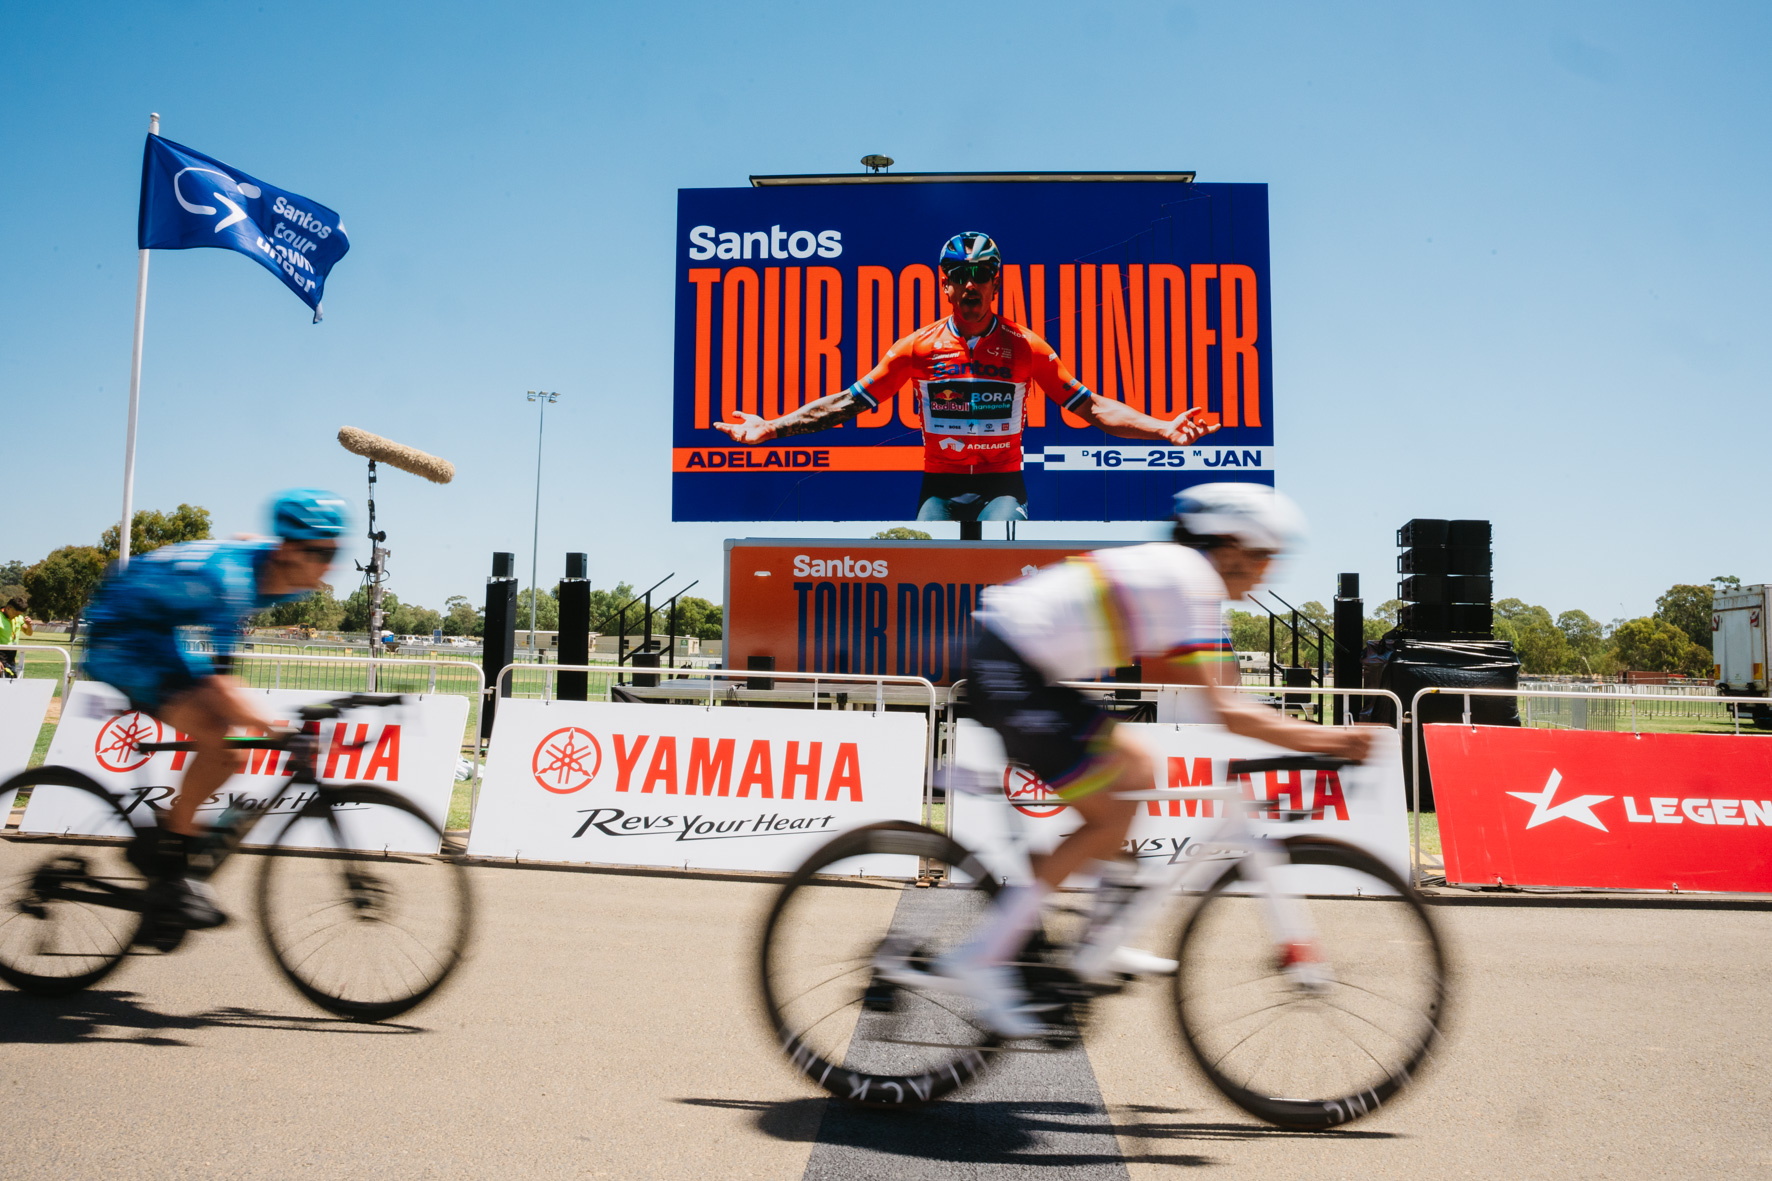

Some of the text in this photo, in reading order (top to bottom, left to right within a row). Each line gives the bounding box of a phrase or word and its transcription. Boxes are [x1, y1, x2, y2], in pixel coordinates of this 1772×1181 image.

[272, 196, 332, 240] Santos
[274, 222, 317, 254] tour
[689, 225, 843, 260] Santos
[265, 234, 314, 275] own
[688, 264, 1262, 430] TOUR DON UNDER
[932, 361, 1012, 379] Santos
[971, 392, 1012, 402] BORA
[686, 451, 830, 468] ADELAIDE
[967, 442, 1011, 450] ADELAIDE
[1203, 450, 1262, 467] JAN
[793, 555, 888, 578] Santos
[793, 581, 888, 682] TOUR
[897, 582, 1002, 683] DOW
[612, 733, 863, 802] YAMAHA
[123, 786, 224, 815] Res
[571, 808, 835, 841] Revs Your Heart
